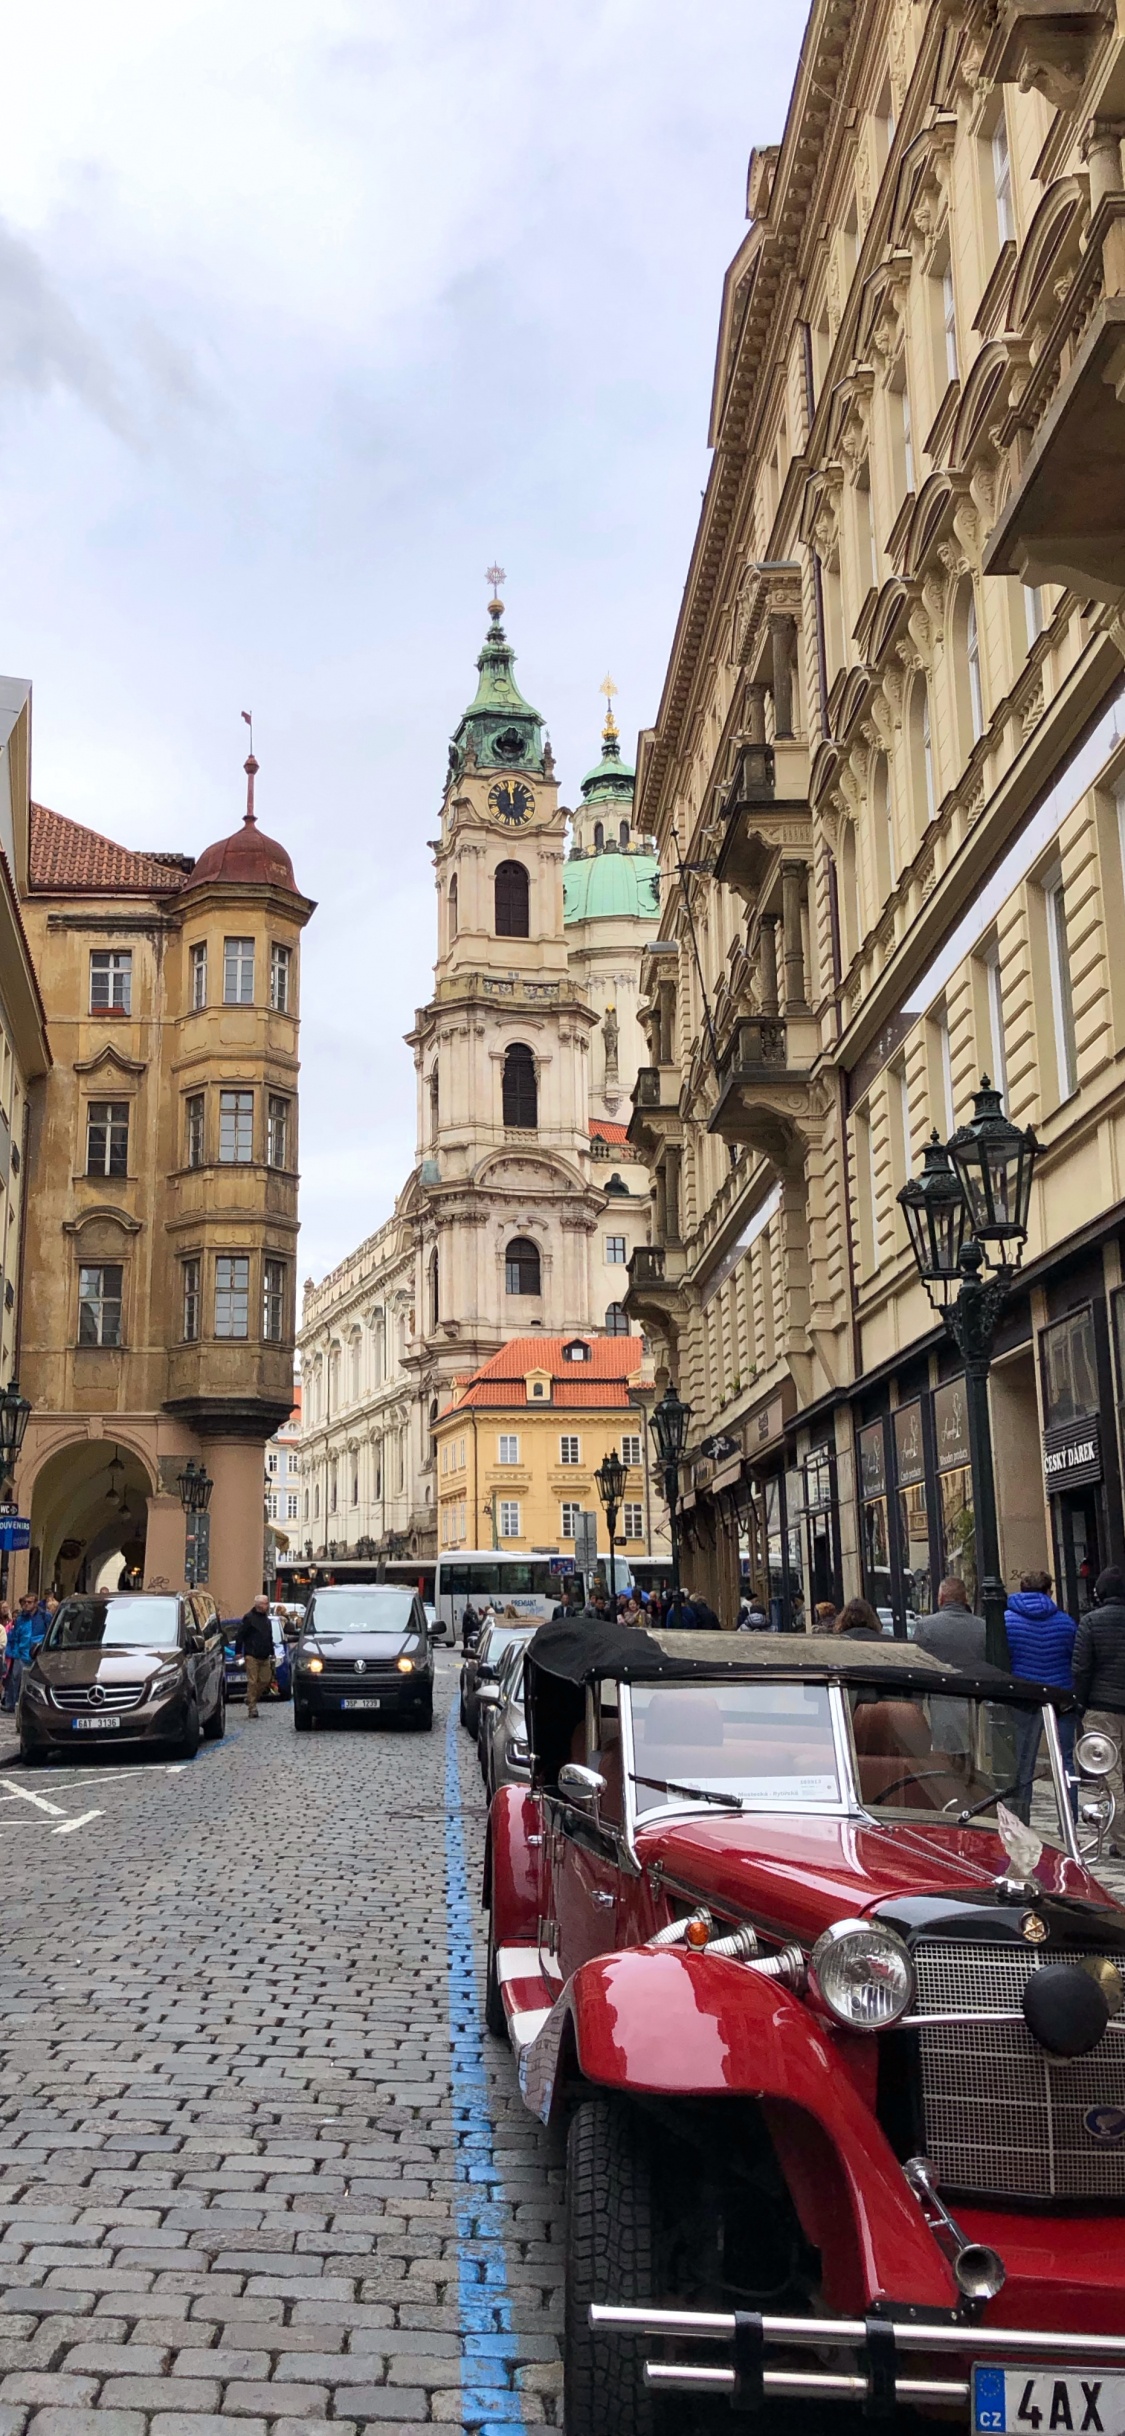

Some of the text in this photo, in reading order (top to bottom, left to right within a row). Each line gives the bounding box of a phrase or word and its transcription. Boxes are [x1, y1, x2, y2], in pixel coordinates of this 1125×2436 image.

[1045, 1441, 1095, 1473] ČESKÝ DÁREK
[0, 1505, 10, 1513] WC
[78, 1718, 117, 1728] 6AT 3136
[1017, 2379, 1105, 2432] 4AX
[979, 2411, 1001, 2427] CZ
